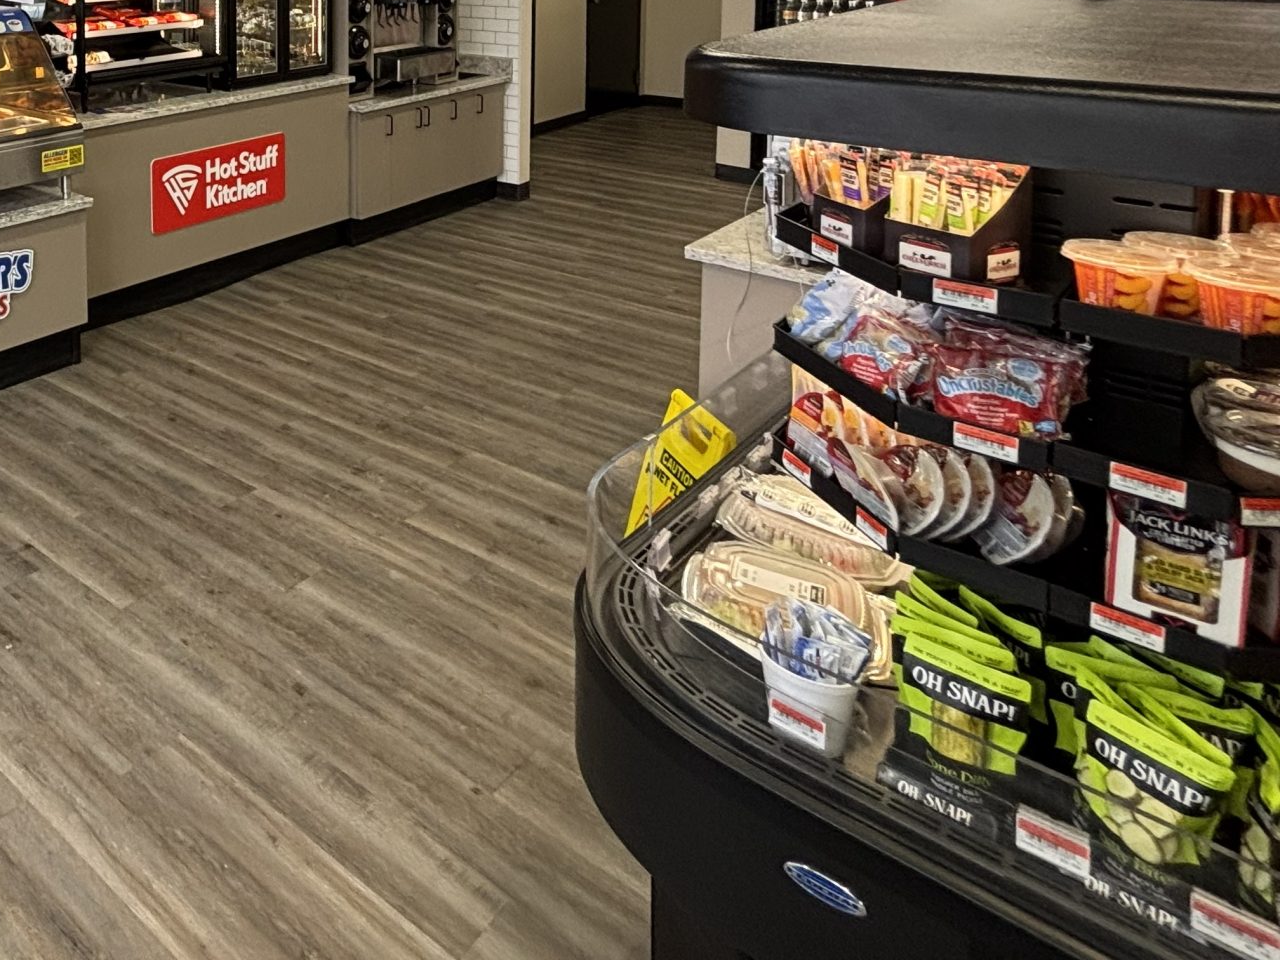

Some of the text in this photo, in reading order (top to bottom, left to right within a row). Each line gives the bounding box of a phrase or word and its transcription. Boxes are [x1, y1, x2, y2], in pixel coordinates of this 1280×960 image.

[205, 144, 279, 183] Hot Stuff
[206, 177, 267, 209] Kitchen
[1128, 509, 1171, 532] JACK
[911, 665, 1018, 722] OH SNAP!
[1094, 738, 1213, 811] OH SNAP!
[897, 780, 919, 800] OH
[923, 792, 974, 827] SNAP!
[1118, 890, 1180, 931] SNAP!
